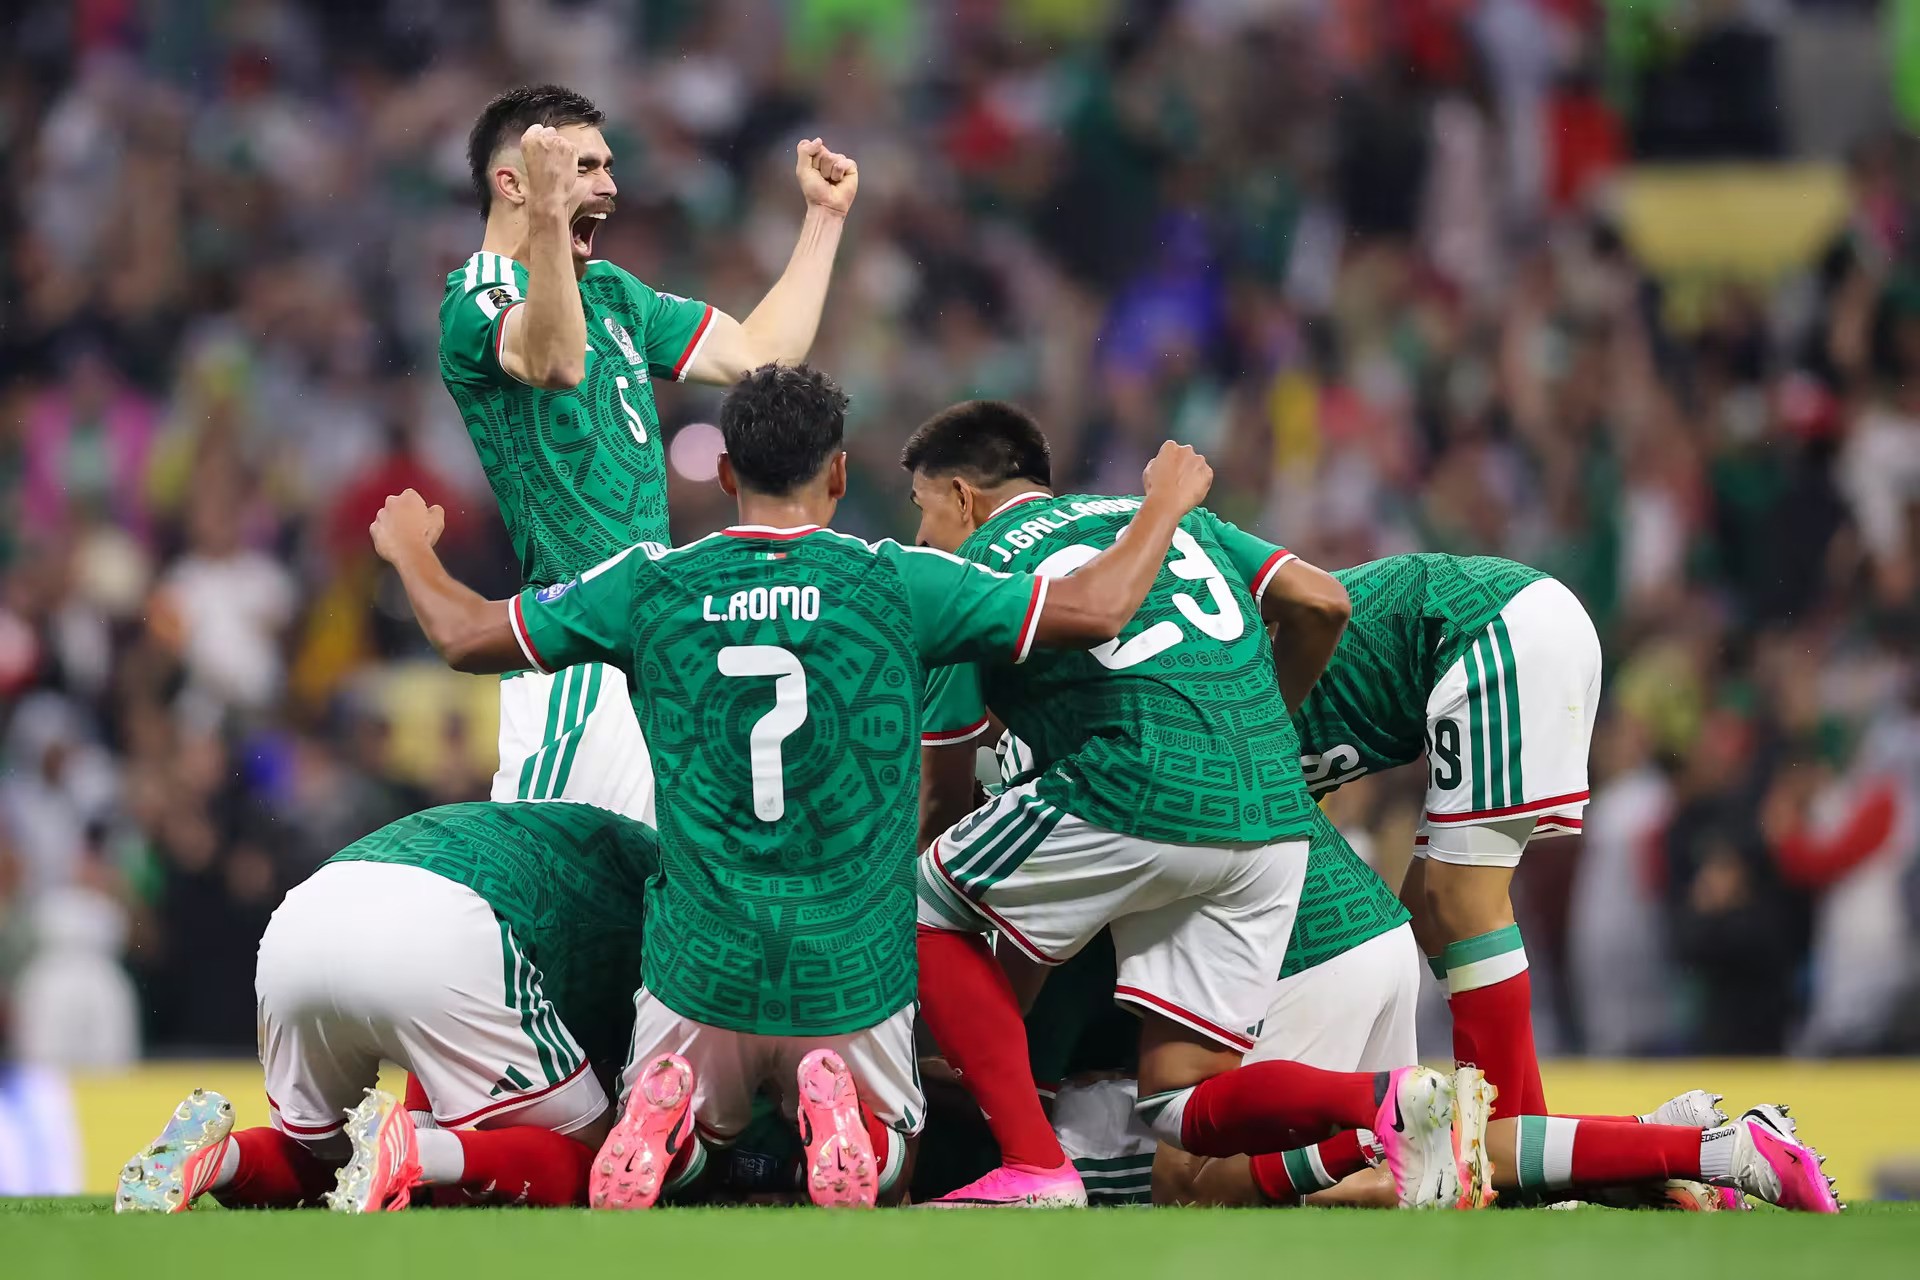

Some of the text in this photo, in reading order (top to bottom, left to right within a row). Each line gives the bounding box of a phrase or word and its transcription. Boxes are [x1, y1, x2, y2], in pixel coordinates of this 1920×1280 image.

[616, 376, 648, 443] 5
[703, 586, 820, 621] L.ROMO
[717, 645, 808, 822] 7
